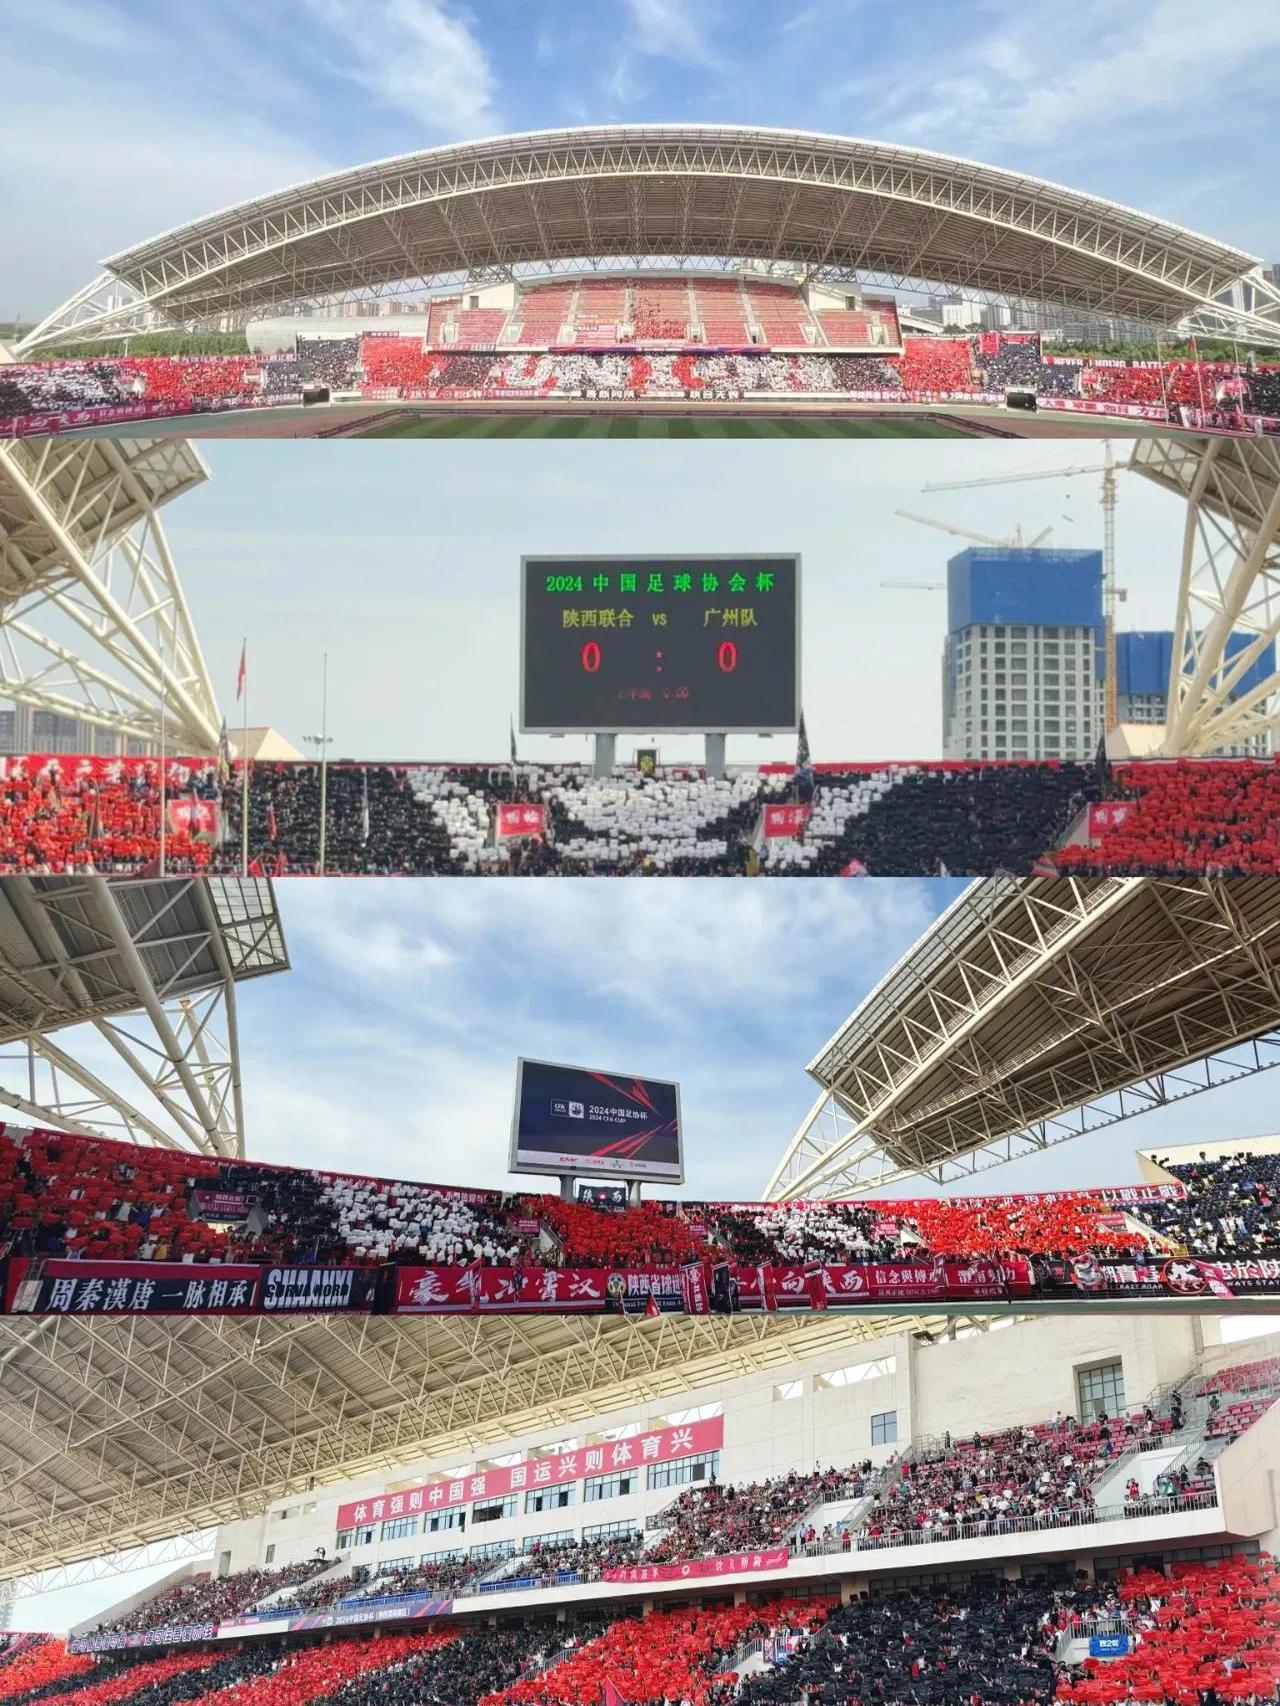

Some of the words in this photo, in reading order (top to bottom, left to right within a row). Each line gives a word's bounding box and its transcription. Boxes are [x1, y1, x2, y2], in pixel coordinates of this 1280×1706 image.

[546, 575, 583, 592] 2024
[592, 572, 775, 593] 中国足球协会杯
[562, 608, 634, 628] 陕西联合
[703, 608, 758, 628] 广州队
[582, 641, 602, 673] 0
[717, 641, 738, 673] 0
[353, 1476, 487, 1522] 体育强则中国强
[510, 1427, 695, 1487] 国运兴则体育兴
